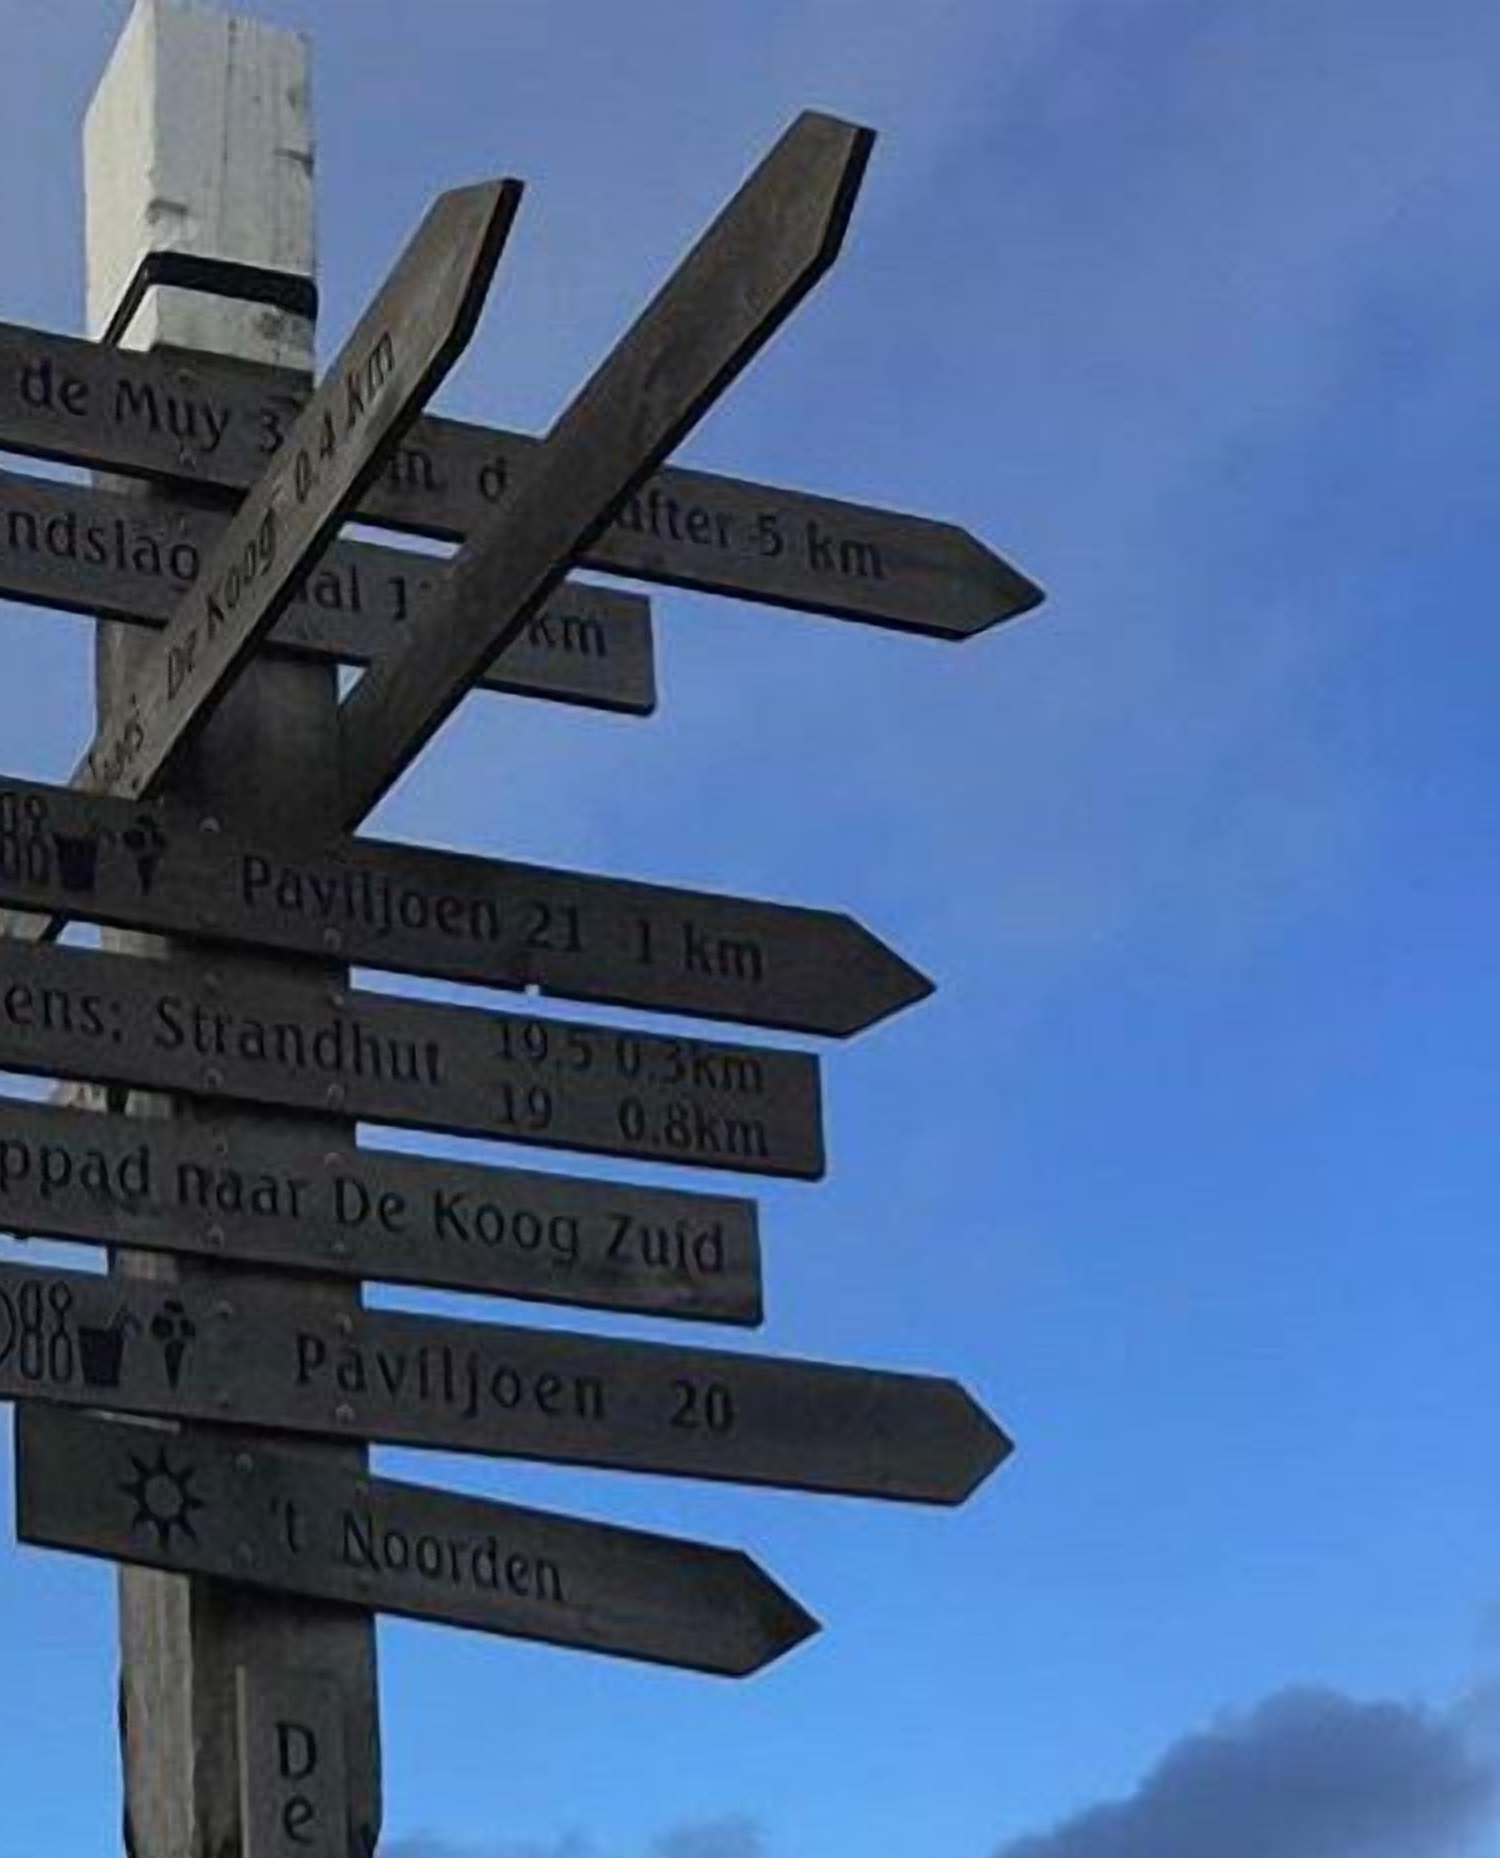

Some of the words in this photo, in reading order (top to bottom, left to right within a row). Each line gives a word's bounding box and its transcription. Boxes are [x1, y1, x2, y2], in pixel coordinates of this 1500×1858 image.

[18, 355, 90, 418] de
[113, 376, 231, 454] Muy
[755, 510, 785, 560] 5
[804, 518, 886, 582] km
[205, 505, 277, 642] Koog
[346, 330, 396, 430] km
[239, 852, 501, 943] Paviljoen
[522, 902, 585, 954] 21
[635, 917, 657, 967] 1
[682, 927, 765, 984] km
[152, 994, 443, 1087] Strandhut
[496, 1018, 594, 1073] 19.5
[495, 1082, 554, 1133] 19
[175, 1154, 307, 1220] naar
[333, 1175, 408, 1234] De
[432, 1186, 582, 1260] Koog
[604, 1210, 728, 1275] Zuid
[295, 1330, 606, 1421] Paviljoen
[668, 1376, 737, 1434] 20
[341, 1506, 566, 1602] Noorden
